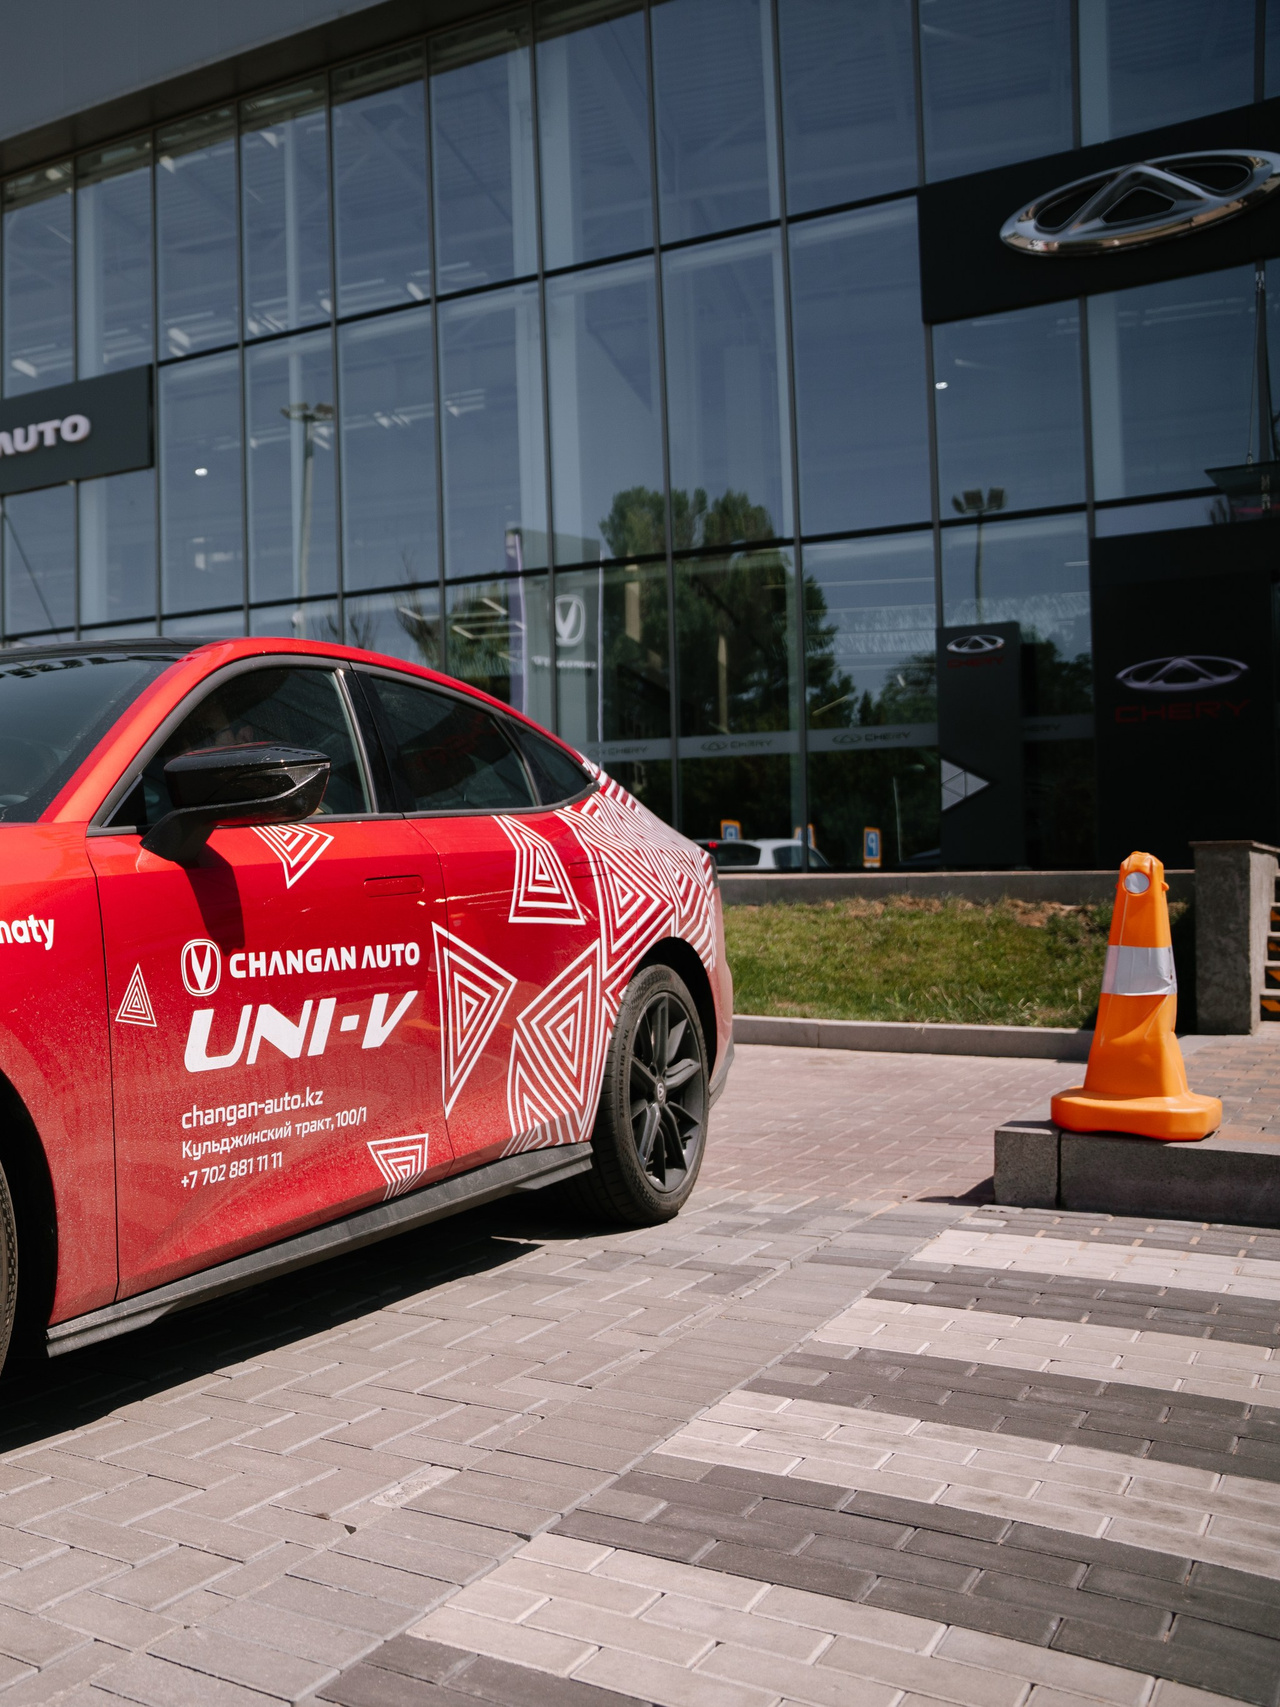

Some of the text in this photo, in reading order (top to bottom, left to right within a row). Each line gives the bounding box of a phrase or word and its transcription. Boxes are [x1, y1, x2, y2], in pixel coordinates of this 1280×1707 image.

[1114, 698, 1252, 724] CHERY
[865, 731, 911, 742] CHERY
[229, 941, 420, 979] CHANGAN AUTO
[184, 990, 419, 1074] UNI-V
[181, 1086, 324, 1129] changan-auto.kz
[182, 1121, 292, 1161] Кульджинский
[335, 1106, 368, 1127] 100/1
[180, 1151, 283, 1190] +7 702 881 11 11
